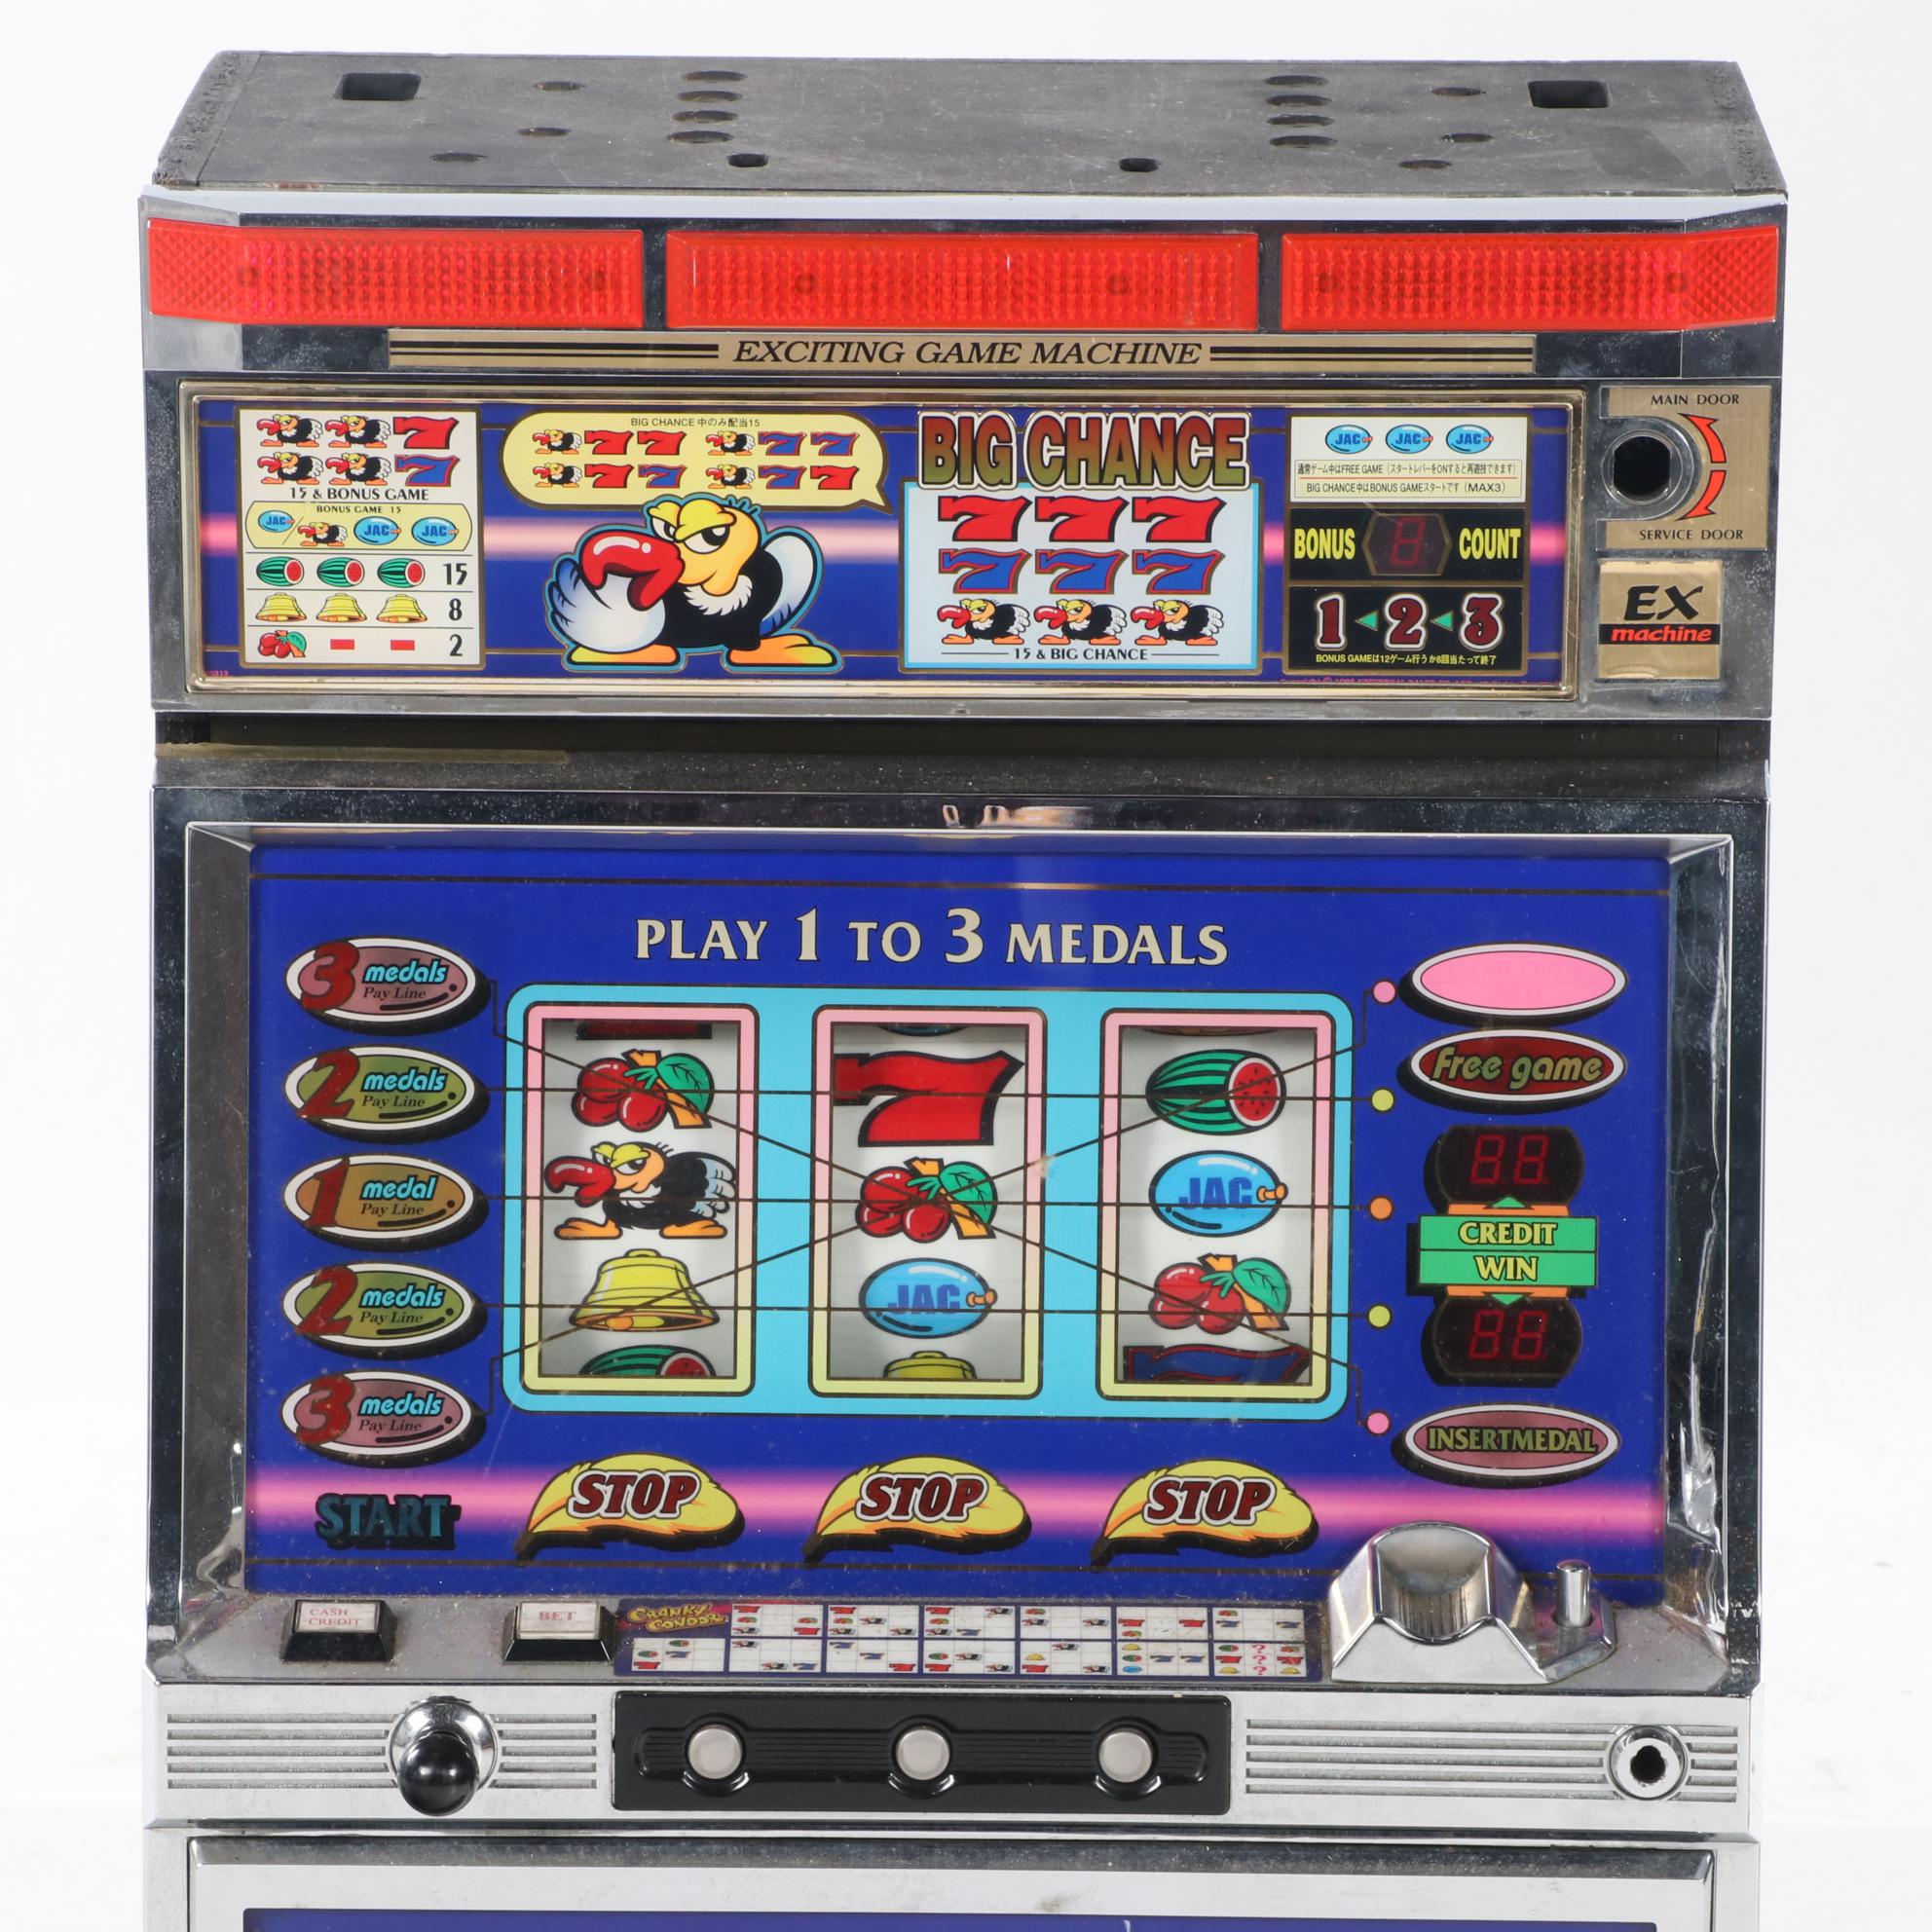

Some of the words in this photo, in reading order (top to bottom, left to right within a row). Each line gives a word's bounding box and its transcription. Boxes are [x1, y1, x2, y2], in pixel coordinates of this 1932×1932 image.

[733, 341, 906, 364] EXCITING
[916, 342, 1022, 364] GAME
[1028, 342, 1203, 365] MACHINE
[1651, 393, 1689, 405] MAIN
[1696, 393, 1739, 405] DOOR
[631, 418, 649, 427] BIG
[651, 418, 694, 427] CHANCE
[1335, 433, 1360, 445] JAC
[1395, 433, 1421, 445] JAC
[1456, 433, 1481, 445] JAC
[920, 415, 1015, 487] BIG
[1025, 415, 1247, 488] CHANCE
[290, 488, 307, 500] 15
[313, 489, 322, 500] &
[327, 488, 380, 501] BONUS
[386, 489, 429, 502] GAME
[1307, 483, 1320, 493] BIG
[354, 505, 383, 514] GAME
[266, 516, 286, 525] JAC
[364, 526, 390, 537] JAC
[422, 526, 447, 537] JAC
[1640, 529, 1695, 541] SERVICE
[1701, 529, 1743, 541] DOOR
[1294, 528, 1356, 560] BONUS
[1459, 528, 1521, 560] COUNT
[443, 562, 467, 586] 15
[448, 598, 463, 621] 8
[1622, 585, 1703, 621] EX
[1317, 595, 1346, 649] 1
[1385, 596, 1427, 650] 2
[1462, 595, 1503, 650] 3
[449, 634, 463, 657] 2
[1612, 626, 1711, 643] machine
[1015, 648, 1030, 660] 15
[1035, 648, 1046, 660] &
[1051, 648, 1079, 660] BIG
[1083, 648, 1148, 661] CHANCE
[1316, 654, 1346, 663] BONUS
[636, 918, 768, 961] PLAY
[796, 909, 819, 962] 1
[848, 921, 921, 964] TO
[946, 907, 985, 964] 3
[1006, 922, 1229, 967] MEDALS
[299, 941, 359, 1010] 3
[363, 959, 450, 984] medals
[363, 987, 390, 1002] Pay
[393, 986, 427, 1000] Line
[1430, 1047, 1501, 1081] Free
[1510, 1056, 1604, 1090] game
[297, 1049, 360, 1120] 2
[361, 1068, 445, 1093] medals
[362, 1096, 389, 1110] Pay
[392, 1095, 426, 1108] Line
[308, 1157, 350, 1227] 1
[360, 1177, 436, 1202] medal
[1178, 1176, 1252, 1211] JAC
[361, 1204, 388, 1218] Pay
[391, 1203, 425, 1216] Line
[1459, 1222, 1558, 1245] CREDIT
[1474, 1257, 1539, 1282] WIN
[295, 1265, 358, 1336] 2
[359, 1285, 443, 1309] medals
[888, 1283, 961, 1317] JAC
[360, 1312, 387, 1326] Pay
[390, 1311, 423, 1324] Line
[295, 1374, 353, 1445] 3
[358, 1393, 443, 1418] medals
[358, 1420, 386, 1434] Pay
[389, 1419, 422, 1432] Line
[571, 1474, 697, 1515] STOP
[860, 1476, 983, 1518] STOP
[1147, 1478, 1273, 1521] STOP
[318, 1495, 448, 1539] START
[539, 1611, 576, 1620] BET
[629, 1604, 708, 1621] CRANKY
[647, 1611, 726, 1632] CONDOR
